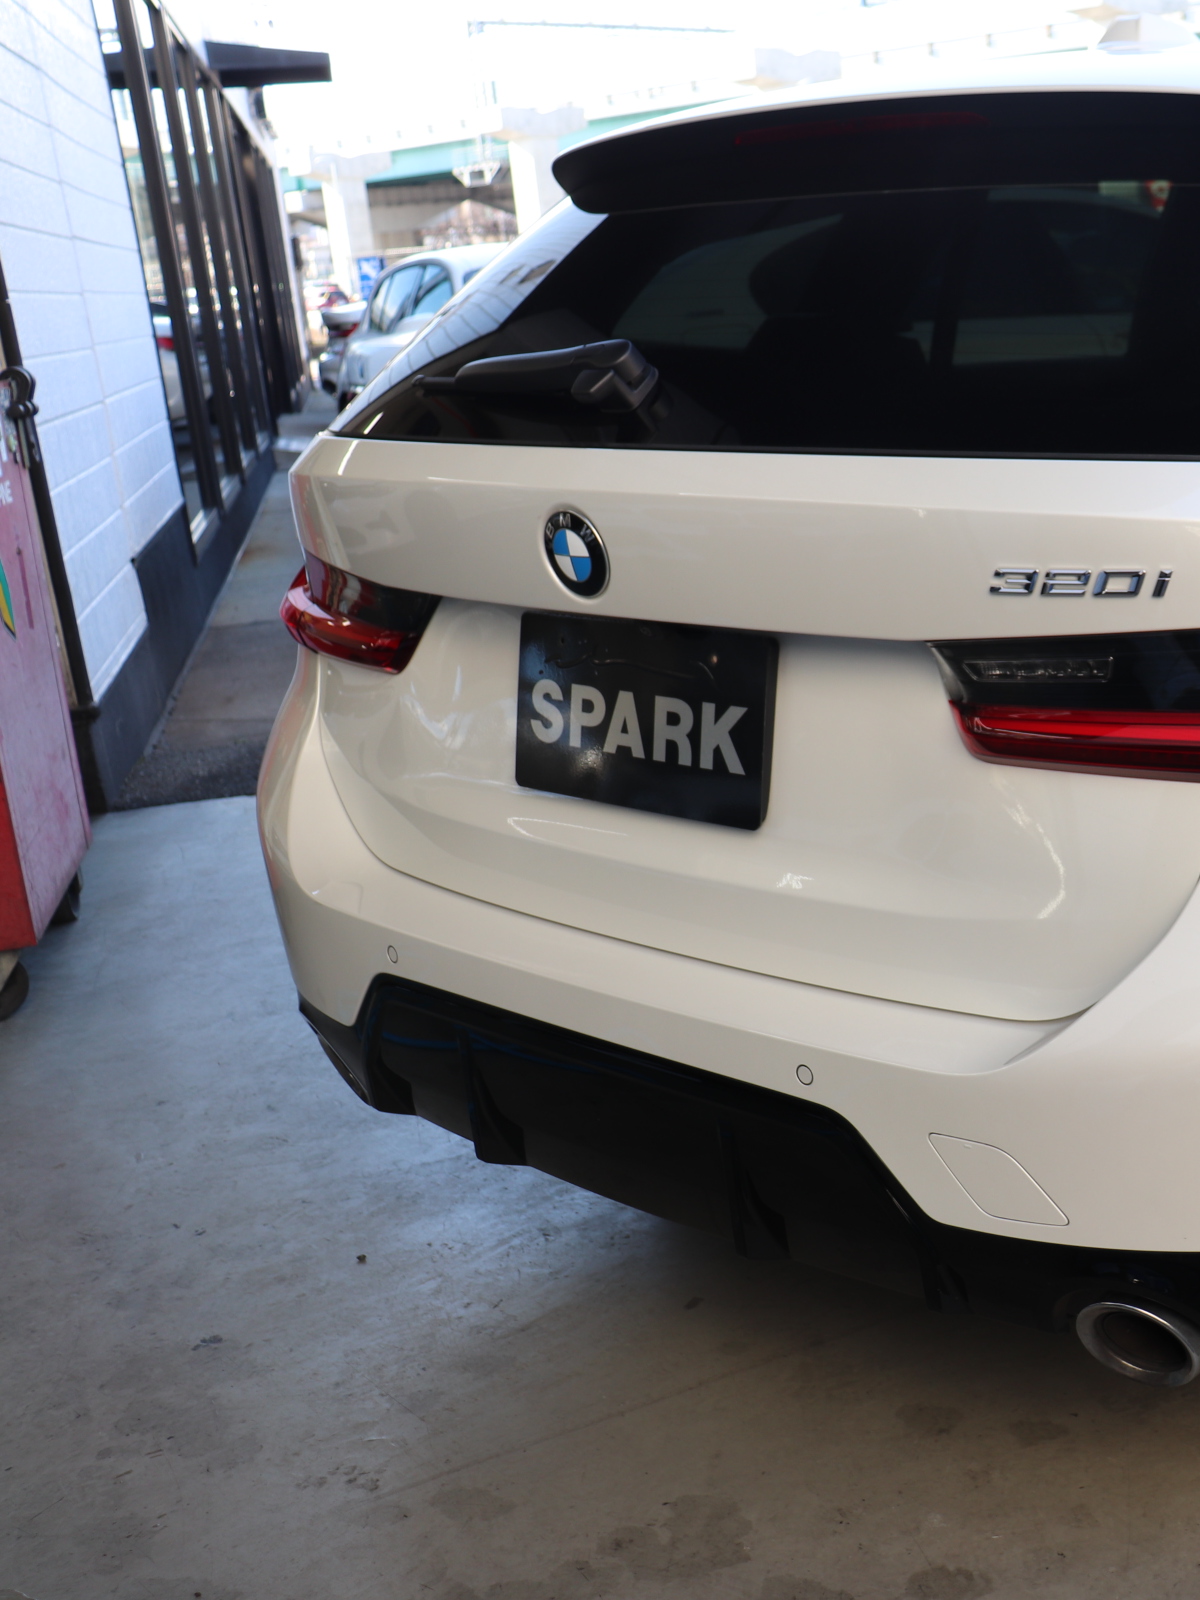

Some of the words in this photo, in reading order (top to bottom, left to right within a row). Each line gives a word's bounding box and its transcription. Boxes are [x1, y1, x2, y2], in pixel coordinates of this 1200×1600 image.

[546, 512, 595, 543] BMW
[989, 568, 1173, 597] 320i
[530, 678, 748, 776] SPARK
